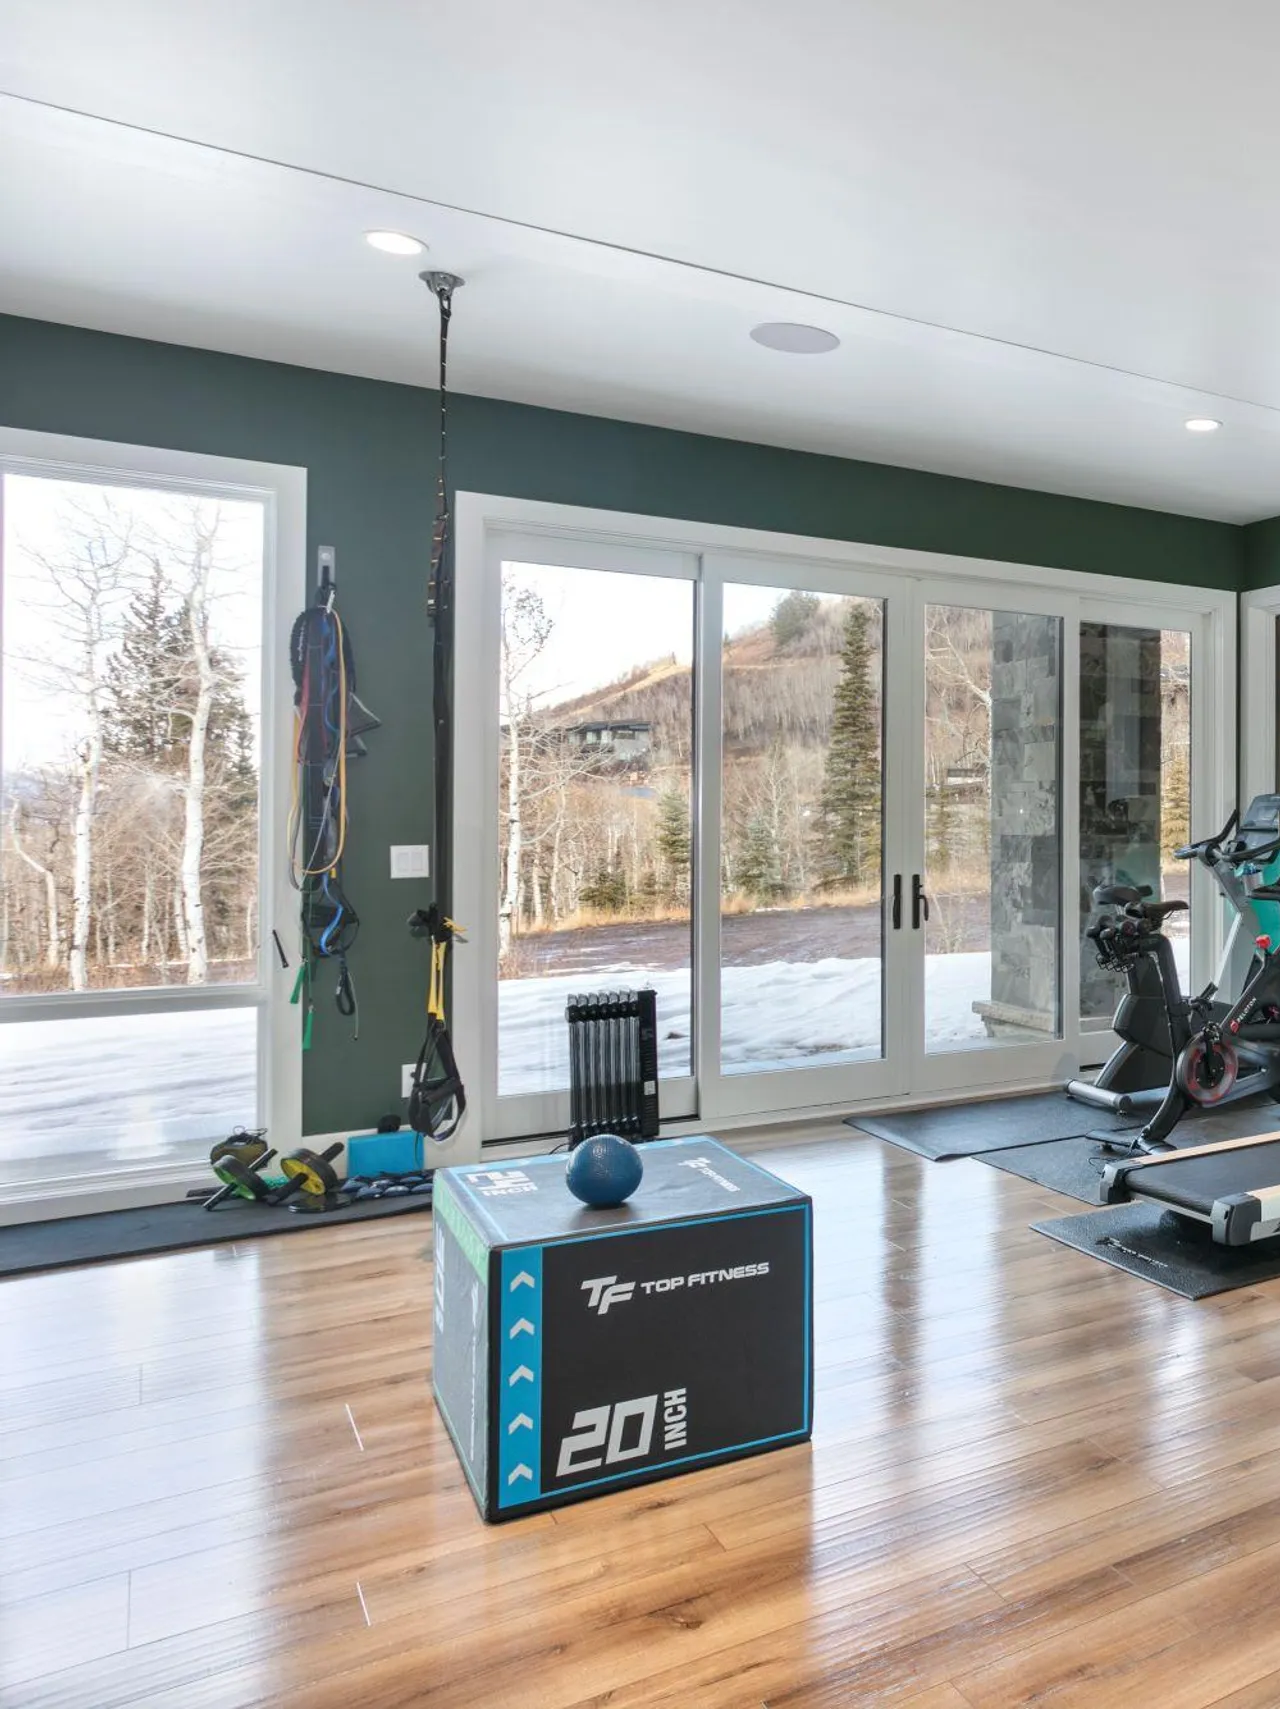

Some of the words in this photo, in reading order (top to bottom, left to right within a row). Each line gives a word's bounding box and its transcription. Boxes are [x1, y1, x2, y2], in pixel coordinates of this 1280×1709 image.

[580, 1275, 636, 1315] TF
[640, 1276, 685, 1294] TOP
[687, 1262, 770, 1287] FITNESS
[555, 1394, 658, 1477] 20
[663, 1387, 687, 1450] INCH
